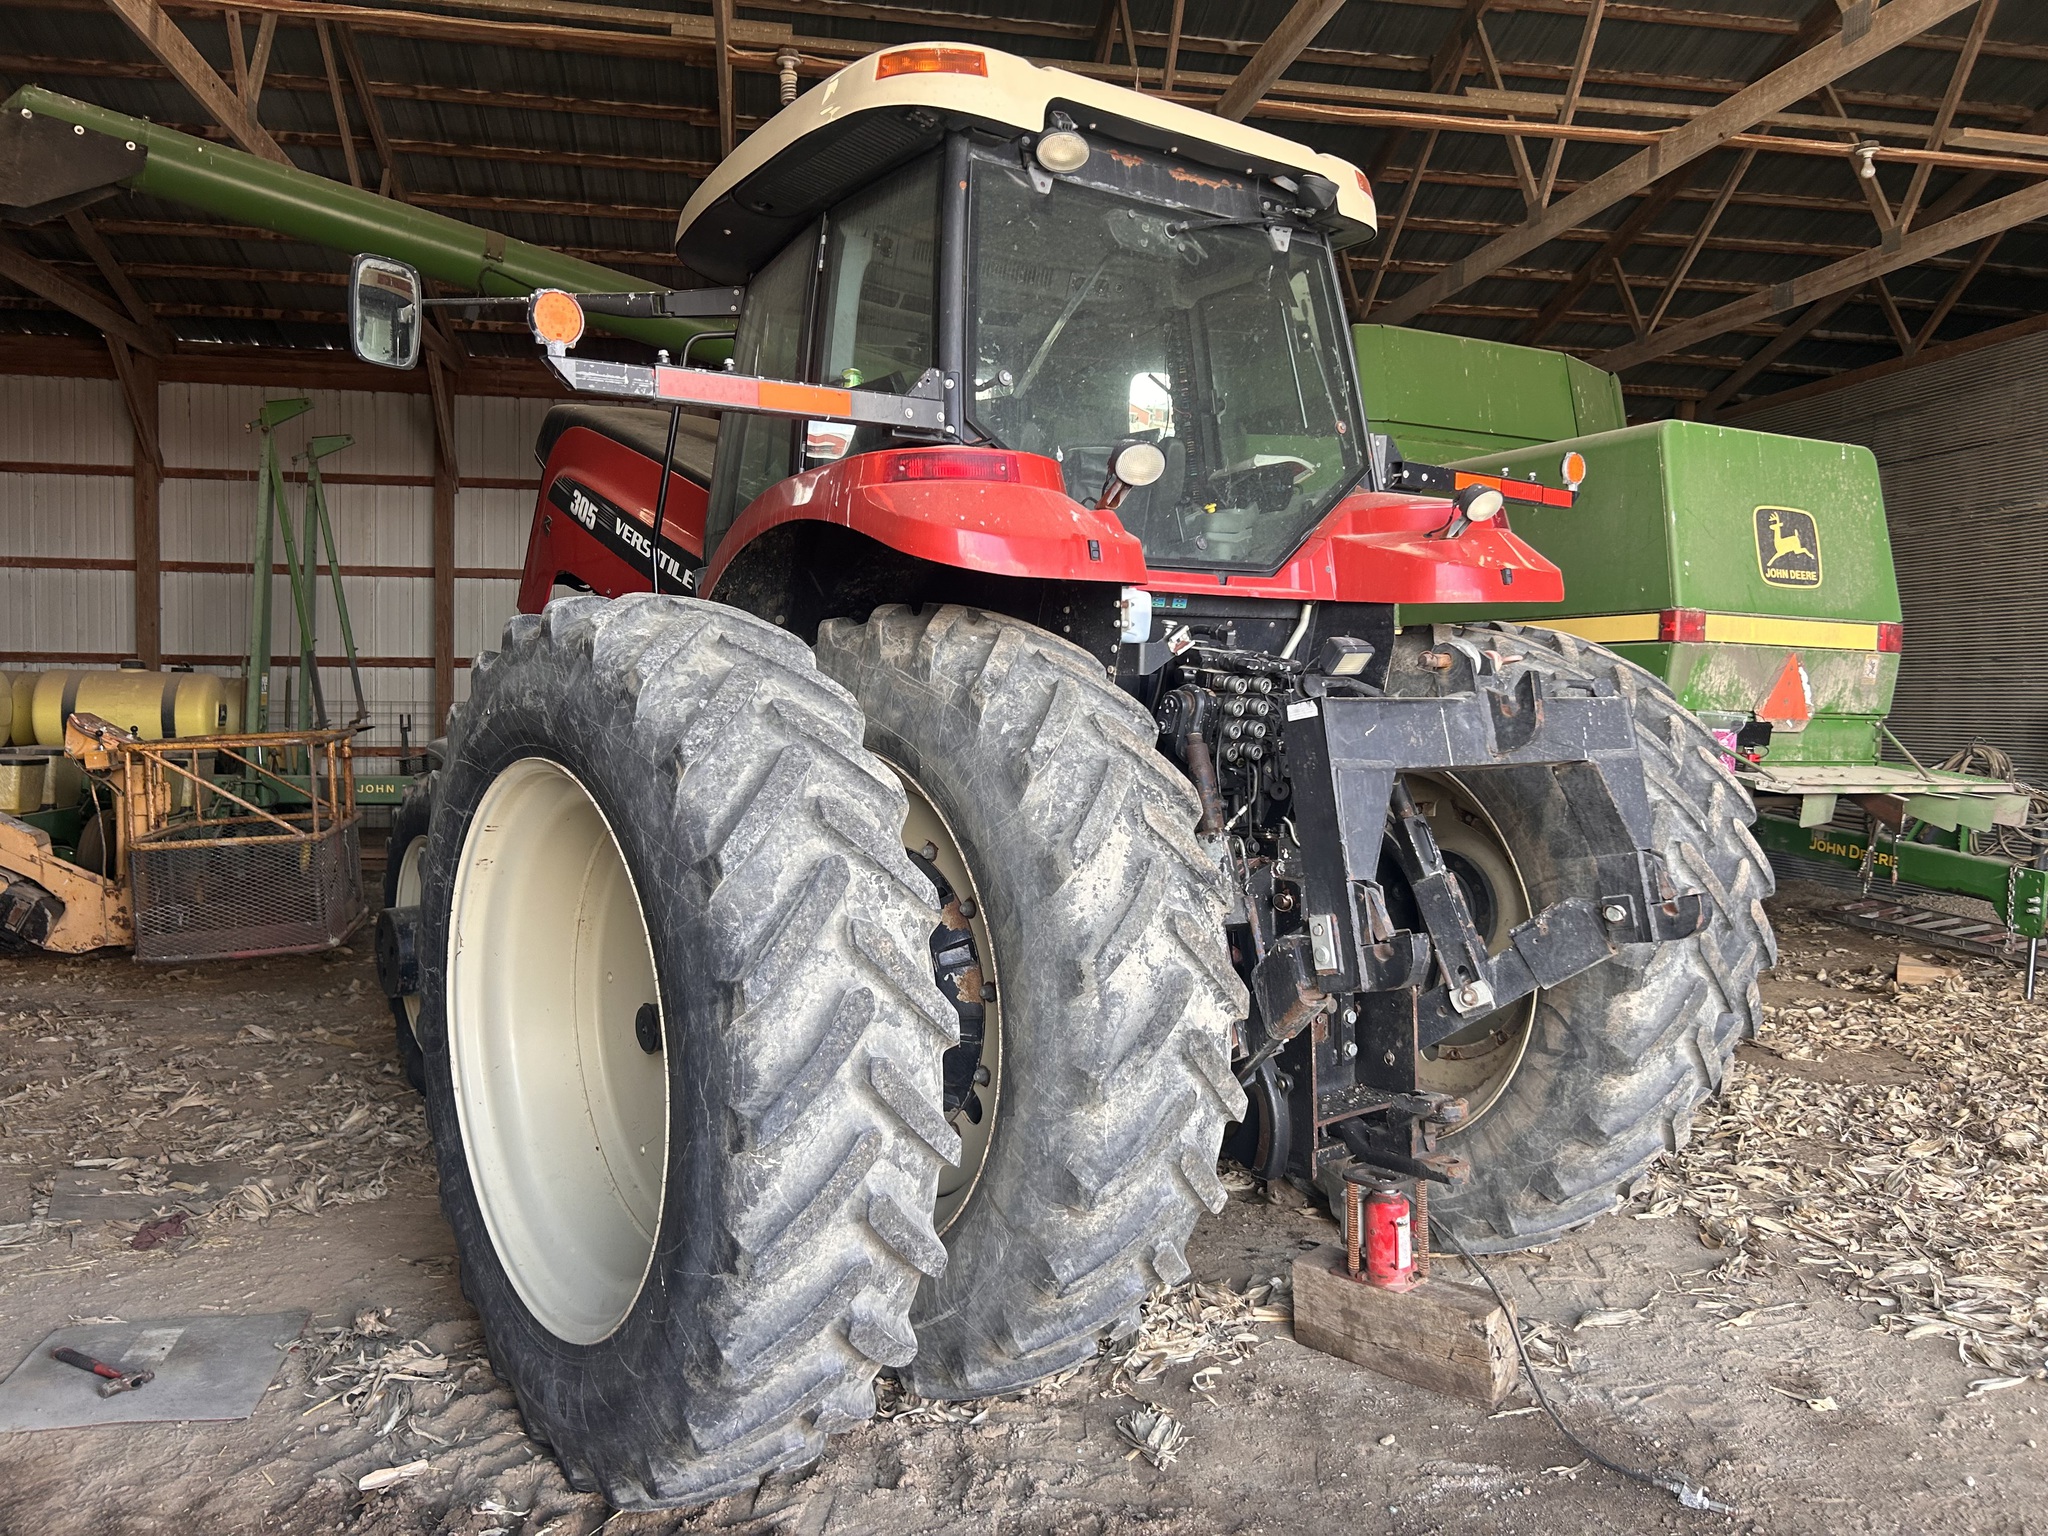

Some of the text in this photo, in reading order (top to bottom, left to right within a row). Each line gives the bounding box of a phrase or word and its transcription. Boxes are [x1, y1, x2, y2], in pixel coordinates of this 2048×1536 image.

[570, 489, 598, 531] 305
[1765, 568, 1817, 580] JOHN DEERE
[357, 784, 395, 793] JOHN
[1809, 837, 1846, 856] JOHN
